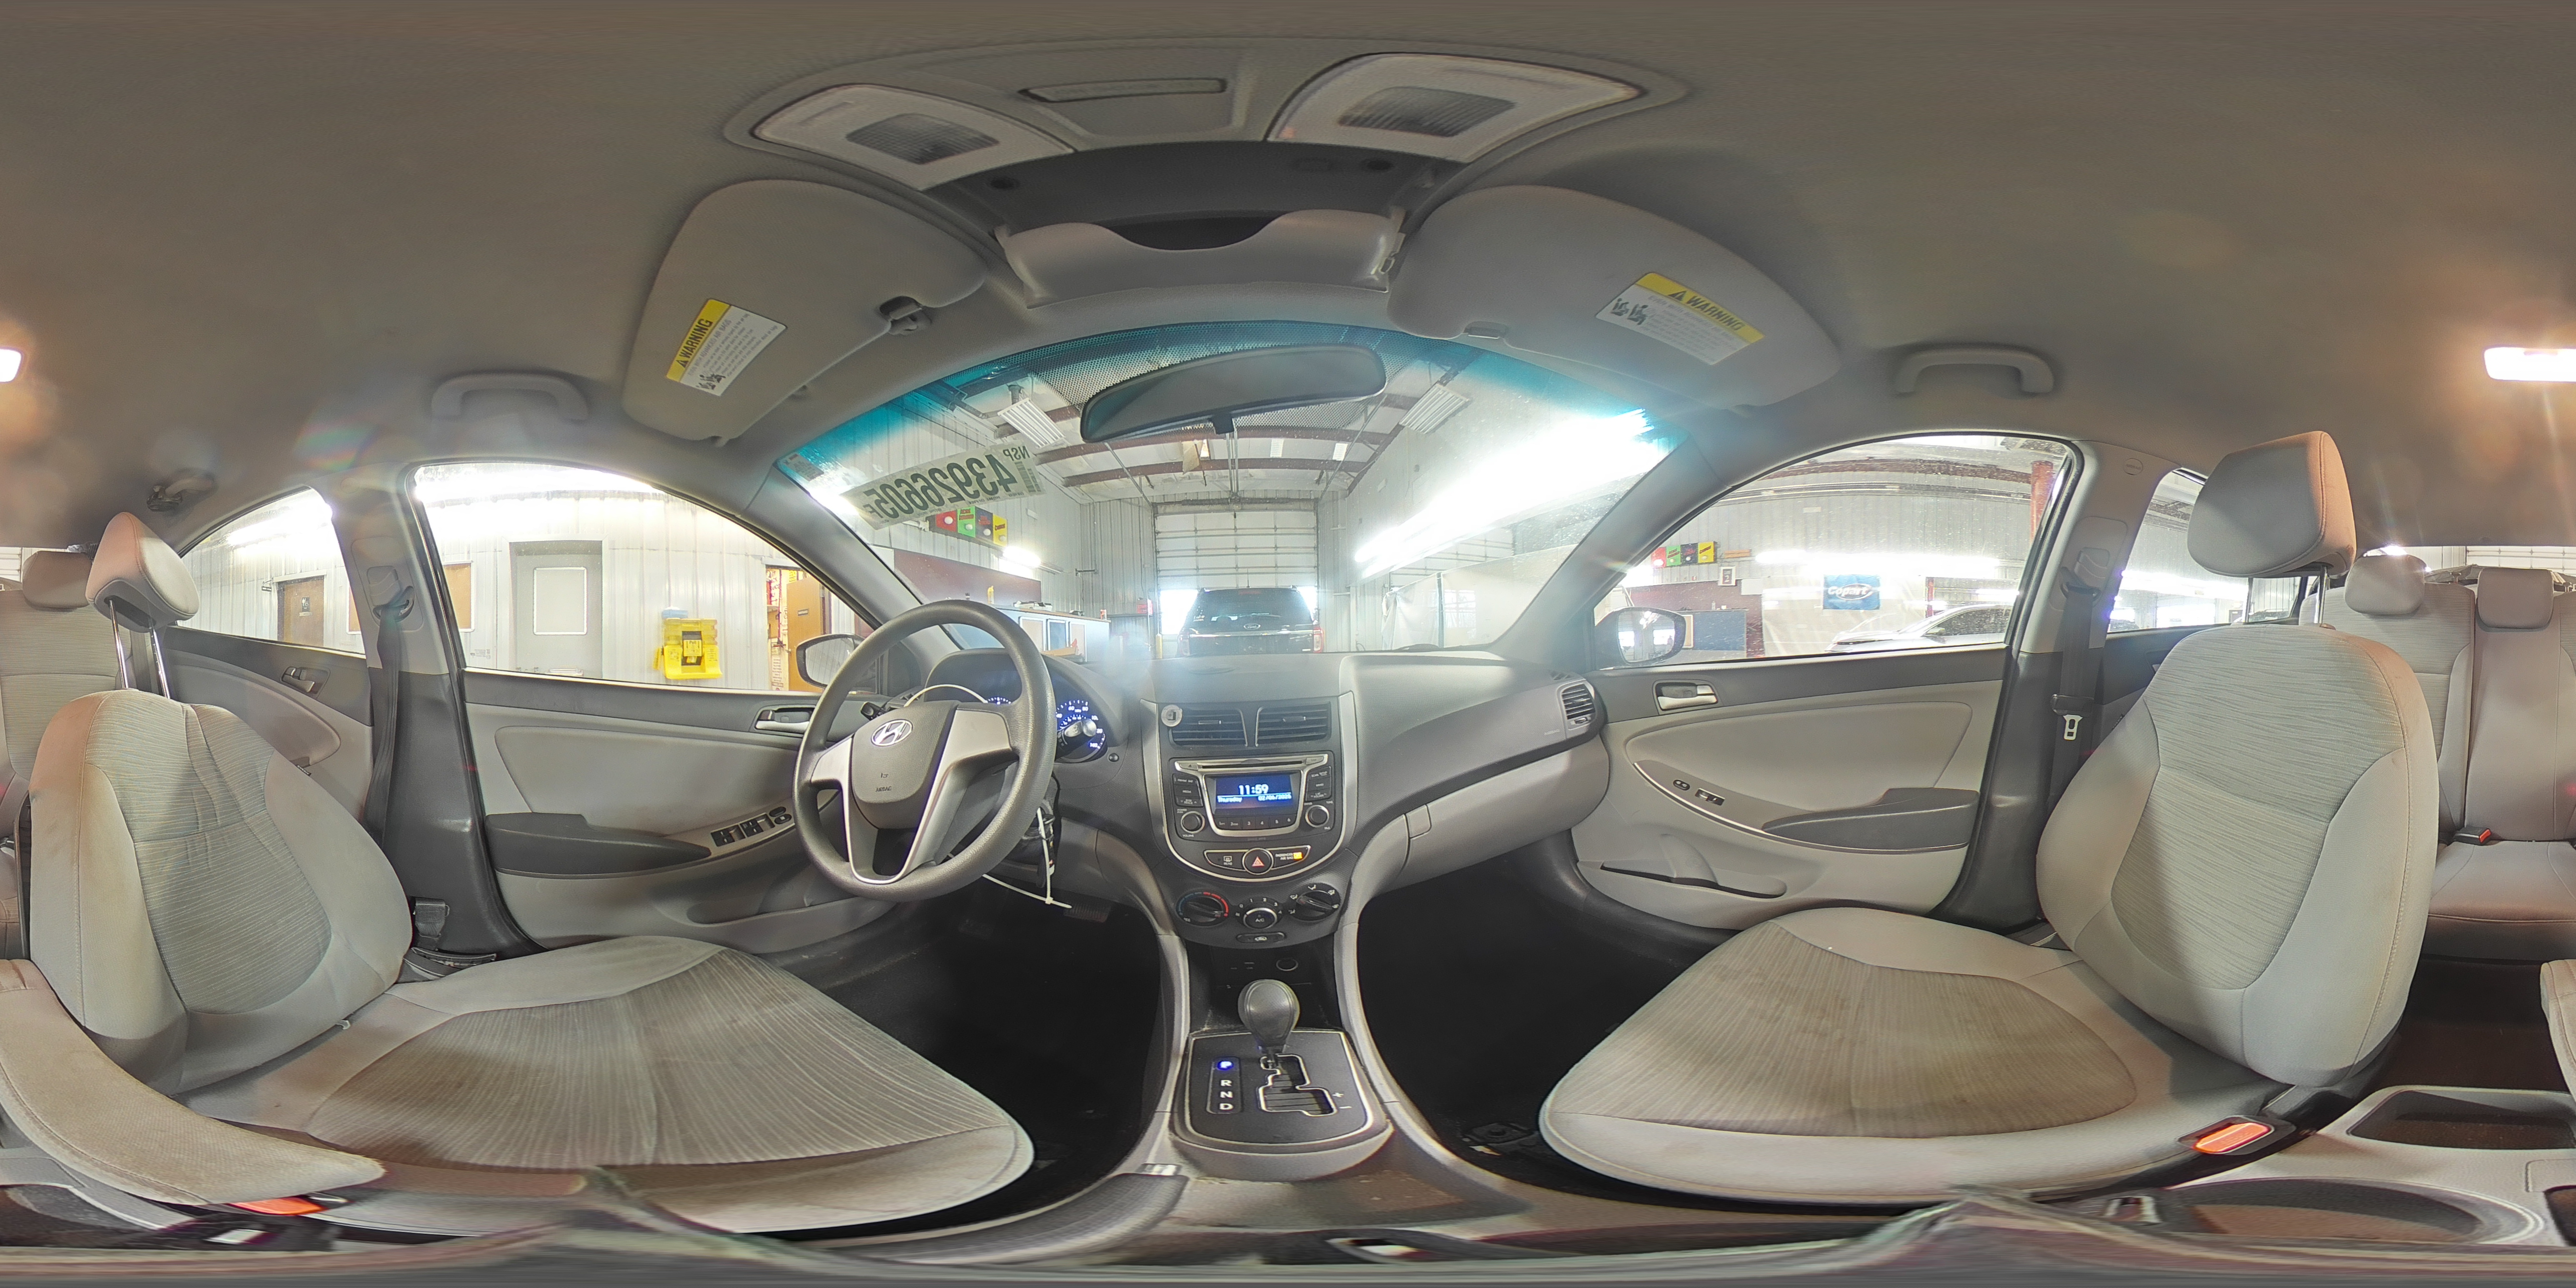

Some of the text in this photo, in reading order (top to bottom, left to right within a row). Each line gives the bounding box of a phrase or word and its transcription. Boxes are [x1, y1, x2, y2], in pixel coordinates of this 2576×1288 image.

[1687, 296, 1745, 331] WARNING
[679, 318, 713, 358] WARNING
[1828, 585, 1868, 598] Copart
[1239, 784, 1269, 795] 11:59
